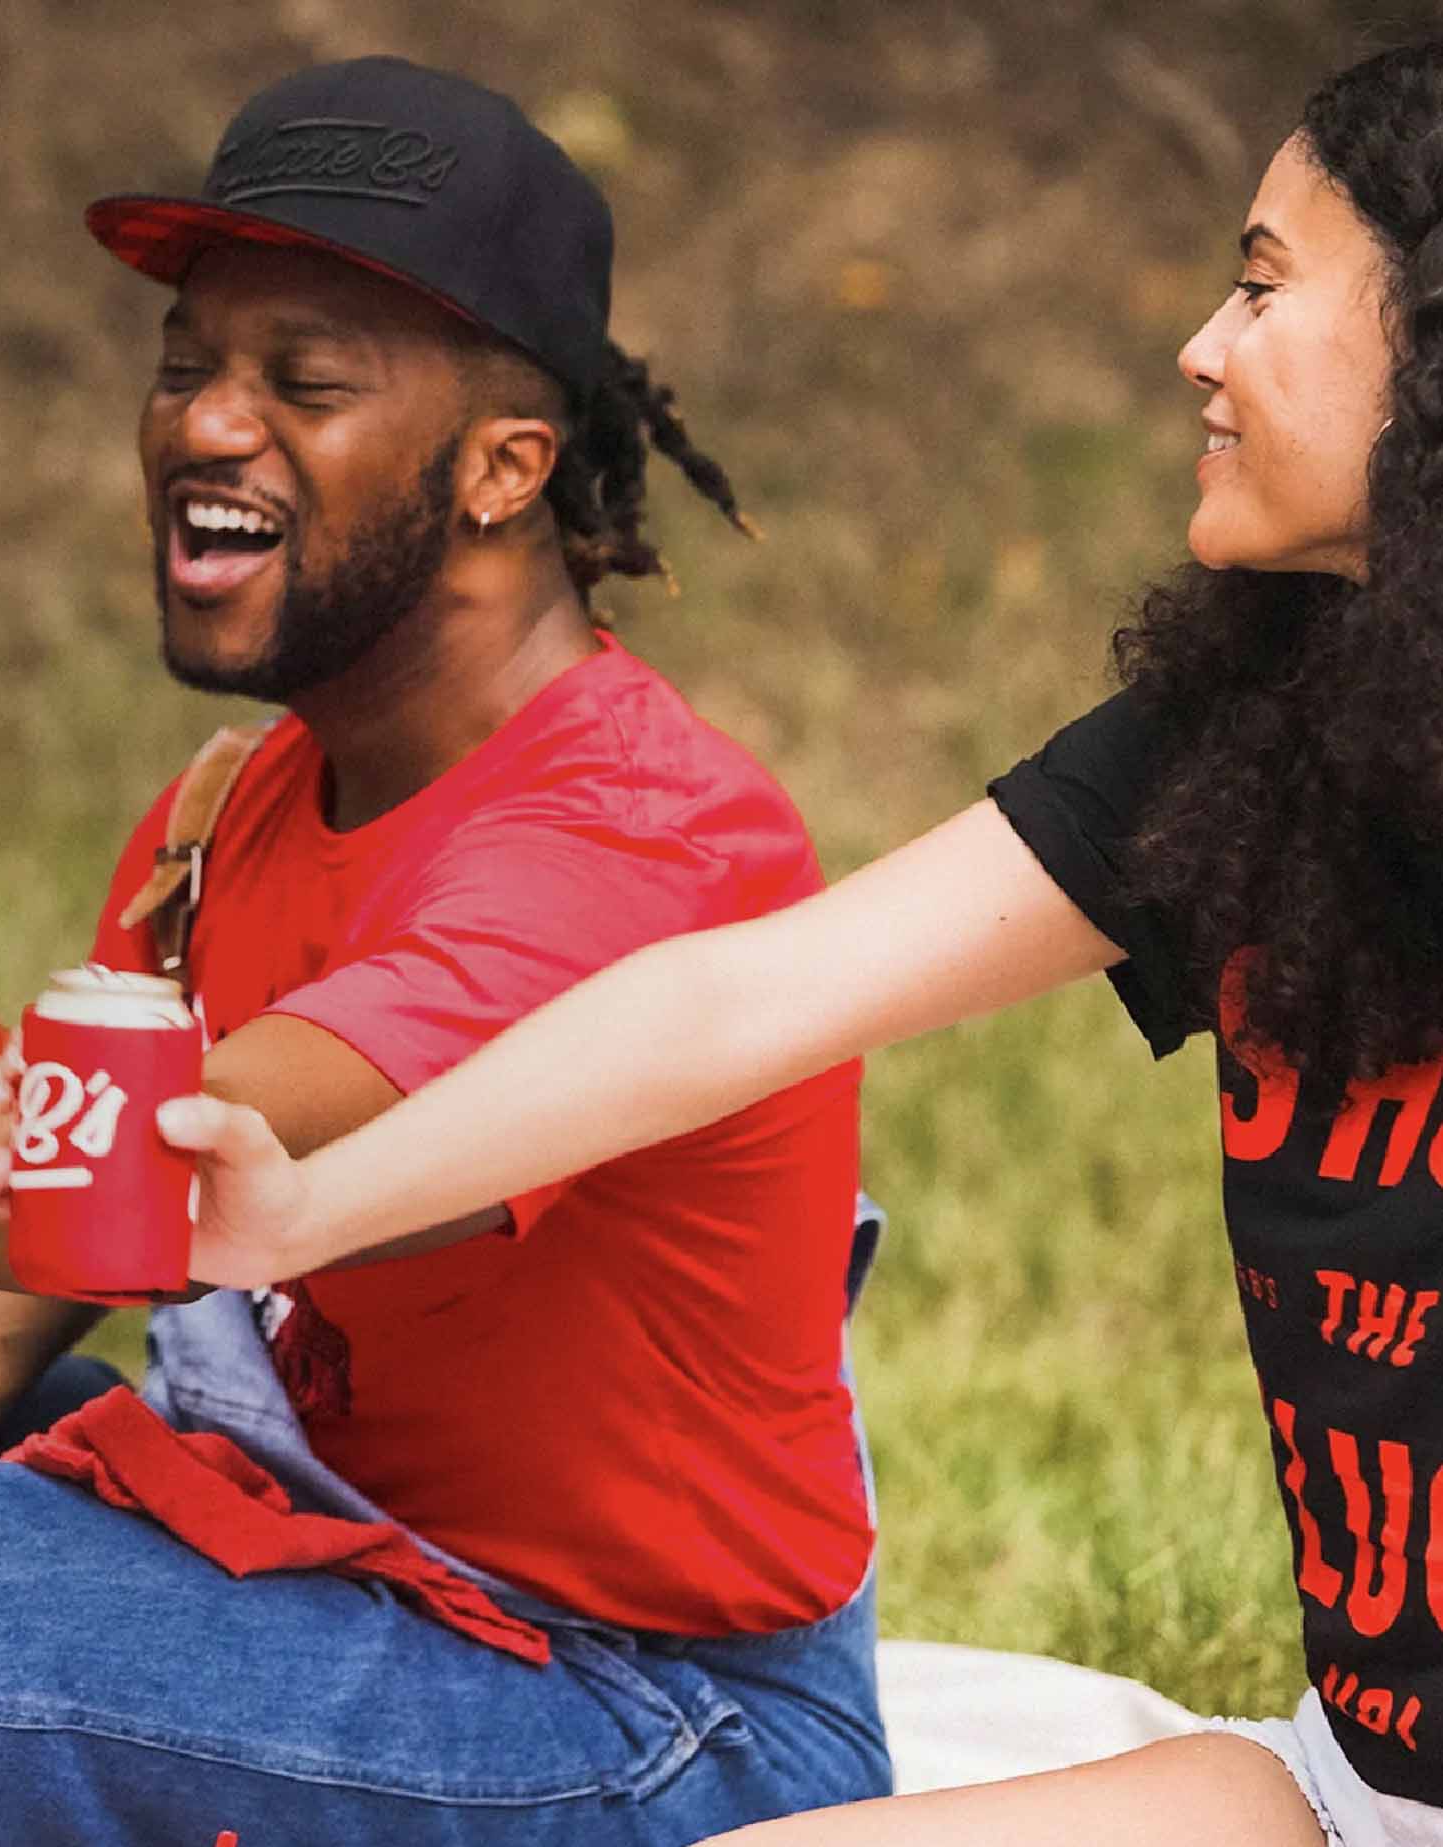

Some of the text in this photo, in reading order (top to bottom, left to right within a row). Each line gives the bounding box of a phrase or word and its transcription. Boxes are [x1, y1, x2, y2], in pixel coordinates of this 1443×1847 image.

[16, 1061, 128, 1164] B's
[1218, 944, 1443, 1188] SH
[1315, 1268, 1440, 1368] THE
